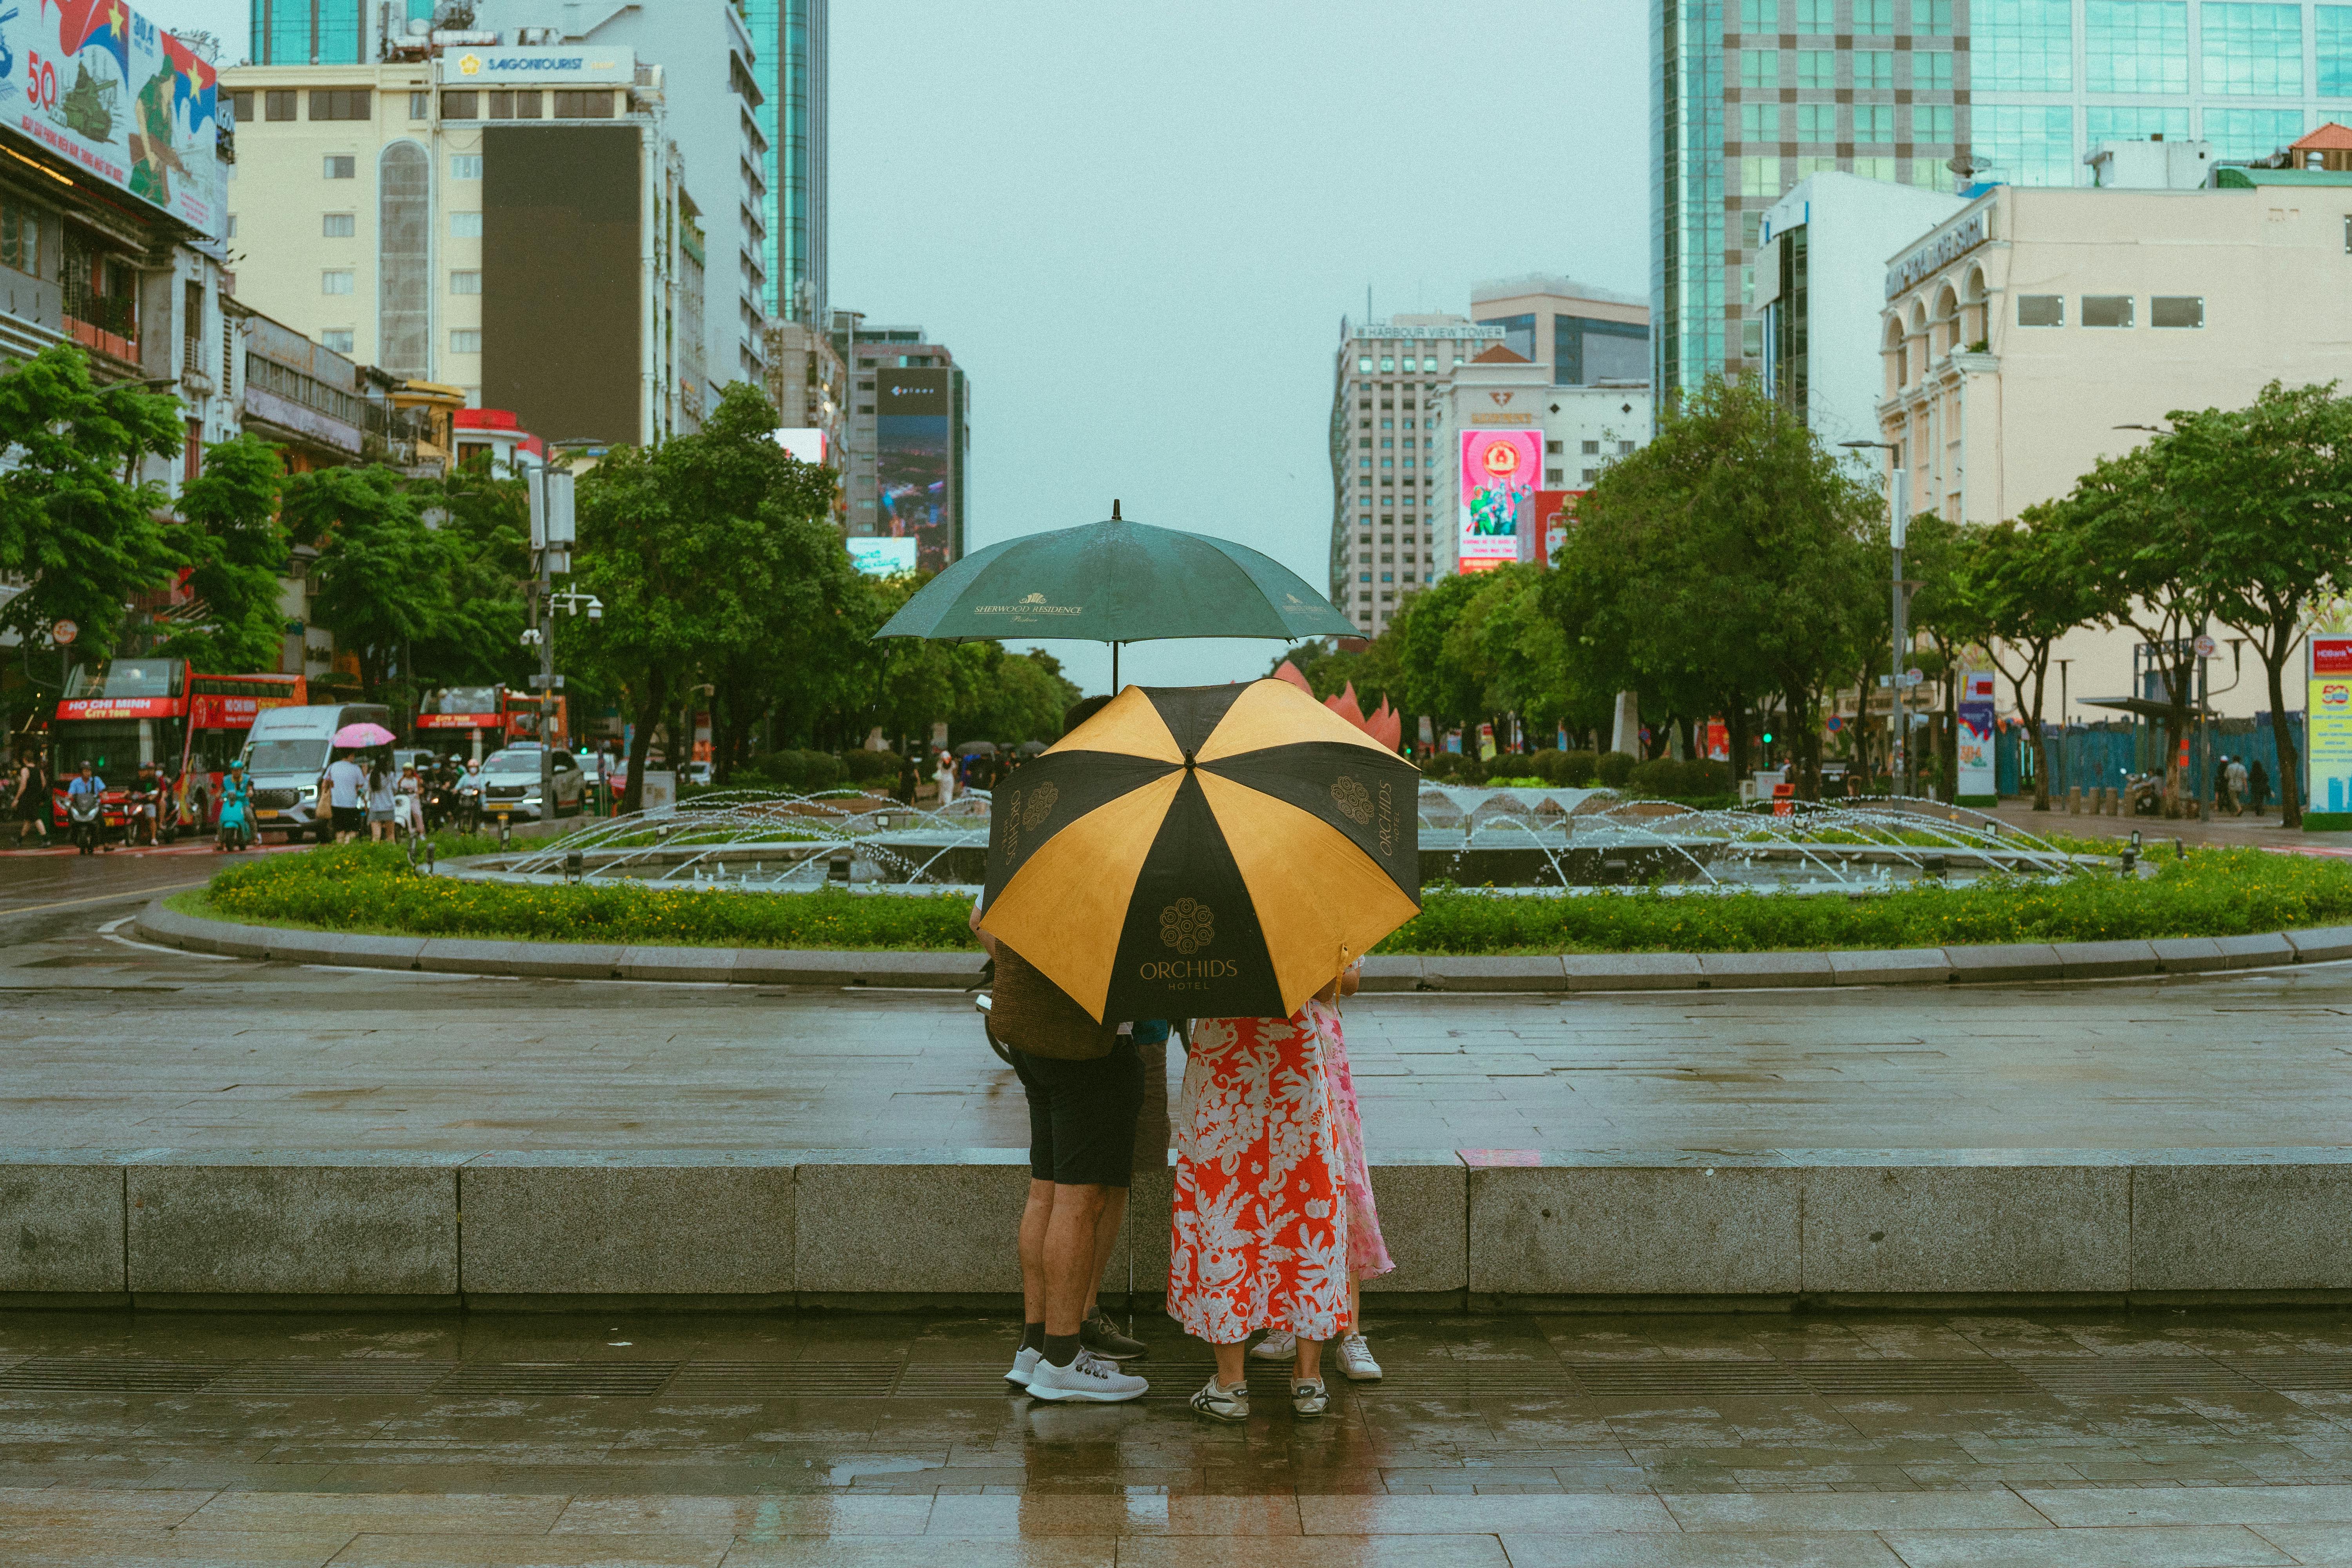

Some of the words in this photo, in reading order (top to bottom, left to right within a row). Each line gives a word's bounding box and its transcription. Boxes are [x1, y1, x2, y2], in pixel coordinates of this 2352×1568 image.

[488, 58, 584, 70] SAIGONTOURIST
[27, 49, 57, 113] 50
[1369, 327, 1425, 337] HARBOUR
[1428, 327, 1456, 337] VIEW
[1461, 327, 1502, 337] TOWER
[69, 701, 87, 710] HO
[90, 700, 113, 709] CHI
[116, 699, 151, 709] MINH
[85, 708, 107, 718] CITY
[1379, 780, 1392, 856] ORCHIDS
[1006, 790, 1020, 865] ORCHIDS
[1140, 960, 1238, 980] ORCHIDS
[1169, 982, 1210, 990] HOTEL
